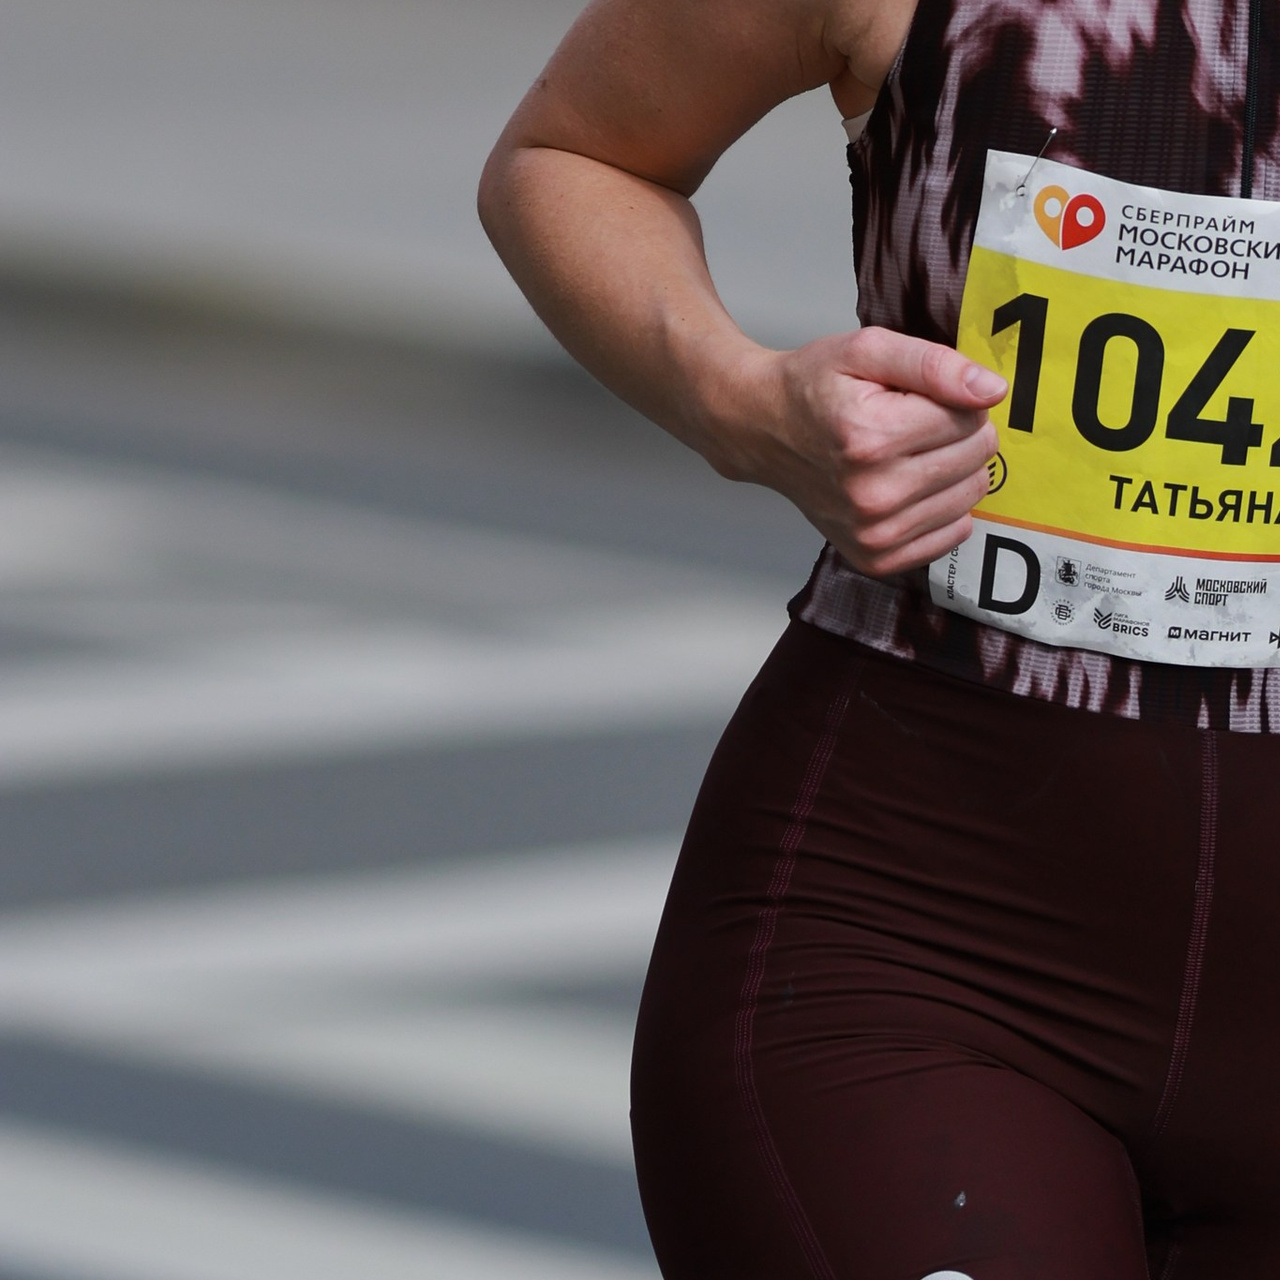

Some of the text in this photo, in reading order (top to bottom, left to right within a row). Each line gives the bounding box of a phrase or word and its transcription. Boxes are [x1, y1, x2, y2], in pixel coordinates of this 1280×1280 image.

[1122, 205, 1255, 234] СБЕРПРАЙМ
[1116, 246, 1250, 280] МАРАФОН
[978, 533, 1041, 615] D
[1085, 564, 1136, 579] Департамент
[1085, 573, 1110, 584] спорта
[947, 563, 957, 600] КЛАСТЕР
[1084, 581, 1142, 597] города Москвы
[1195, 578, 1268, 594] МОСКОВСКИЙ
[1194, 591, 1229, 607] СПОРТ
[1112, 623, 1149, 637] BRICS
